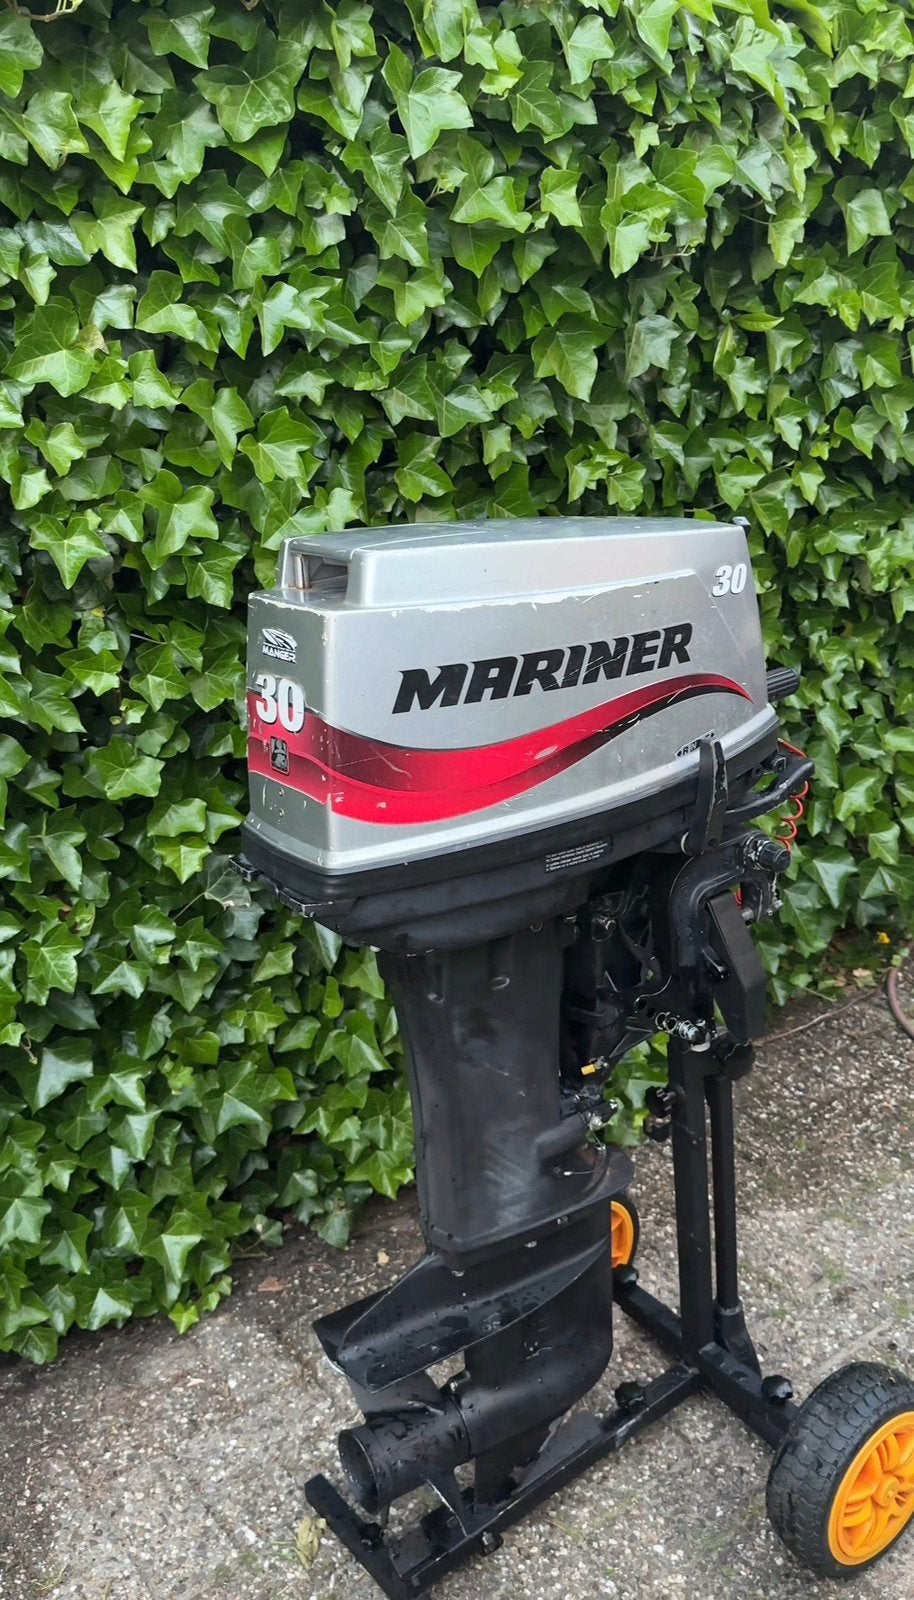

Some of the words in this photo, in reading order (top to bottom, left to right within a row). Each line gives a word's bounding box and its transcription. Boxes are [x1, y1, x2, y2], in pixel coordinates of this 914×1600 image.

[712, 563, 747, 597] 30
[392, 622, 693, 714] MARINER
[255, 673, 304, 734] 30
